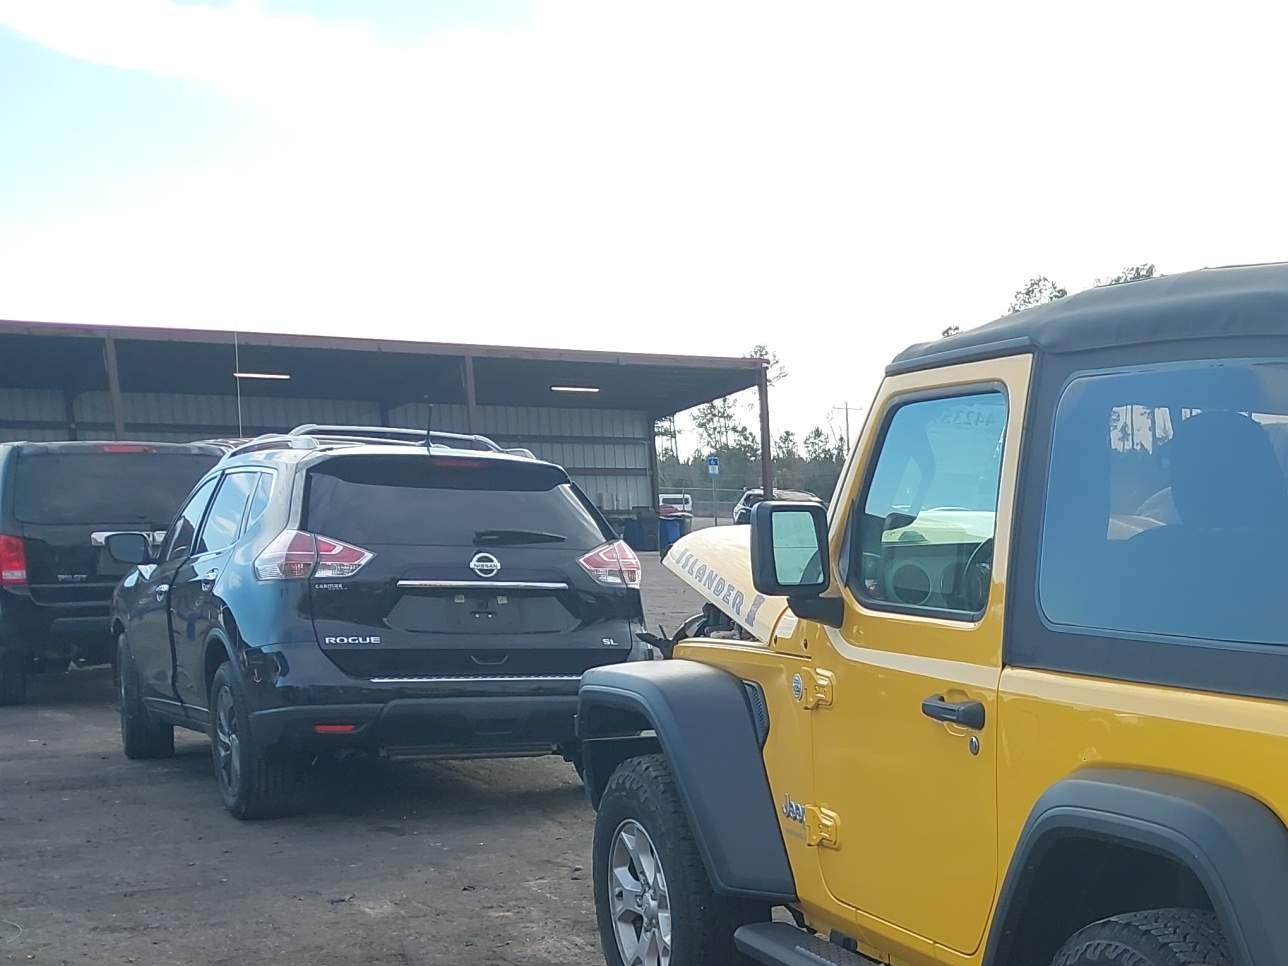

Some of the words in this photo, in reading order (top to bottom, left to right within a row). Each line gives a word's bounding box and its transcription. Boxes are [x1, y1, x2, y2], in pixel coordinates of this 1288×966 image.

[474, 561, 497, 570] NISSAN
[676, 547, 745, 616] ISLANDER
[325, 635, 382, 645] ROGUE
[602, 638, 618, 647] SL
